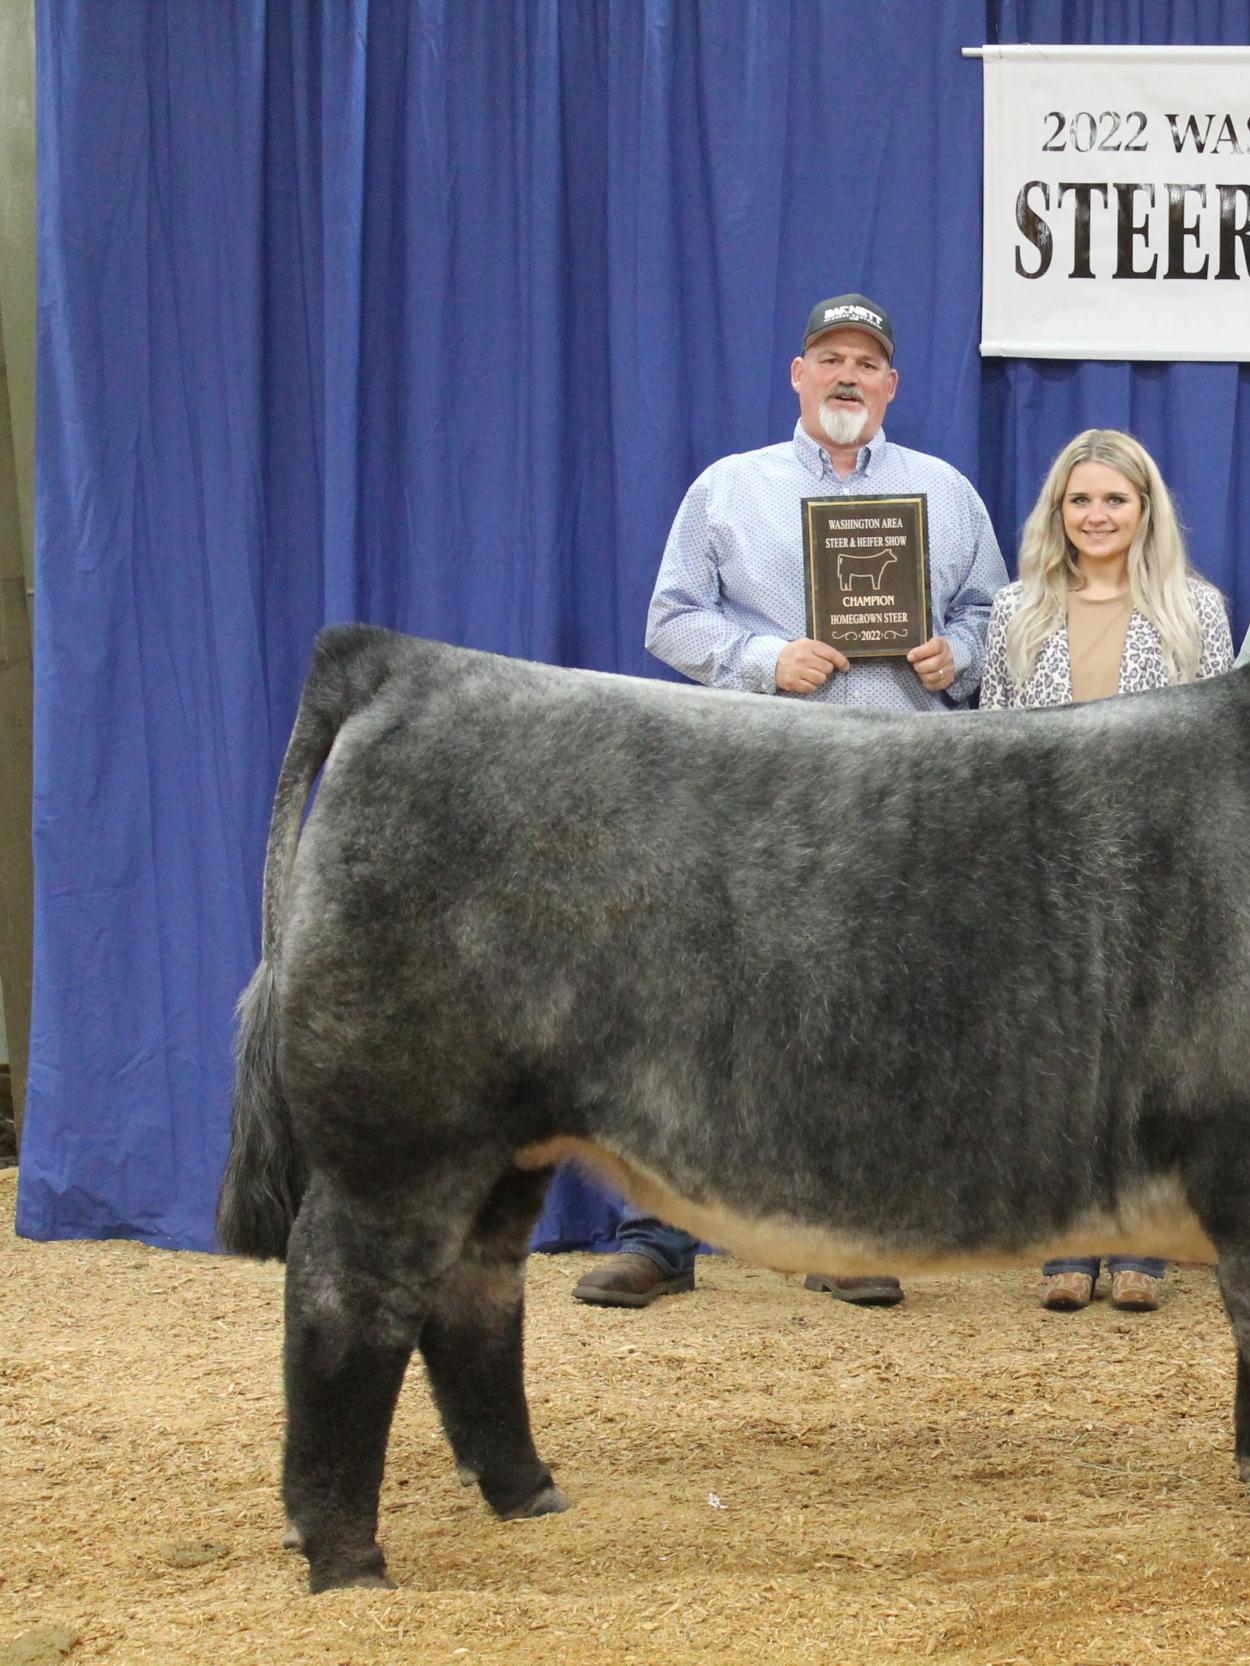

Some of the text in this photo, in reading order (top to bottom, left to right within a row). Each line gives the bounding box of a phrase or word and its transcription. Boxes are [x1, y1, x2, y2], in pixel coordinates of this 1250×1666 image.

[1041, 111, 1149, 154] 2022
[828, 518, 903, 530] WASHINGTON AREA
[825, 536, 907, 549] STEER & HEIFER SHOW
[842, 595, 895, 607] CHAMPION
[830, 612, 908, 625] HOMEGROWN STEER
[861, 630, 881, 641] 2022
